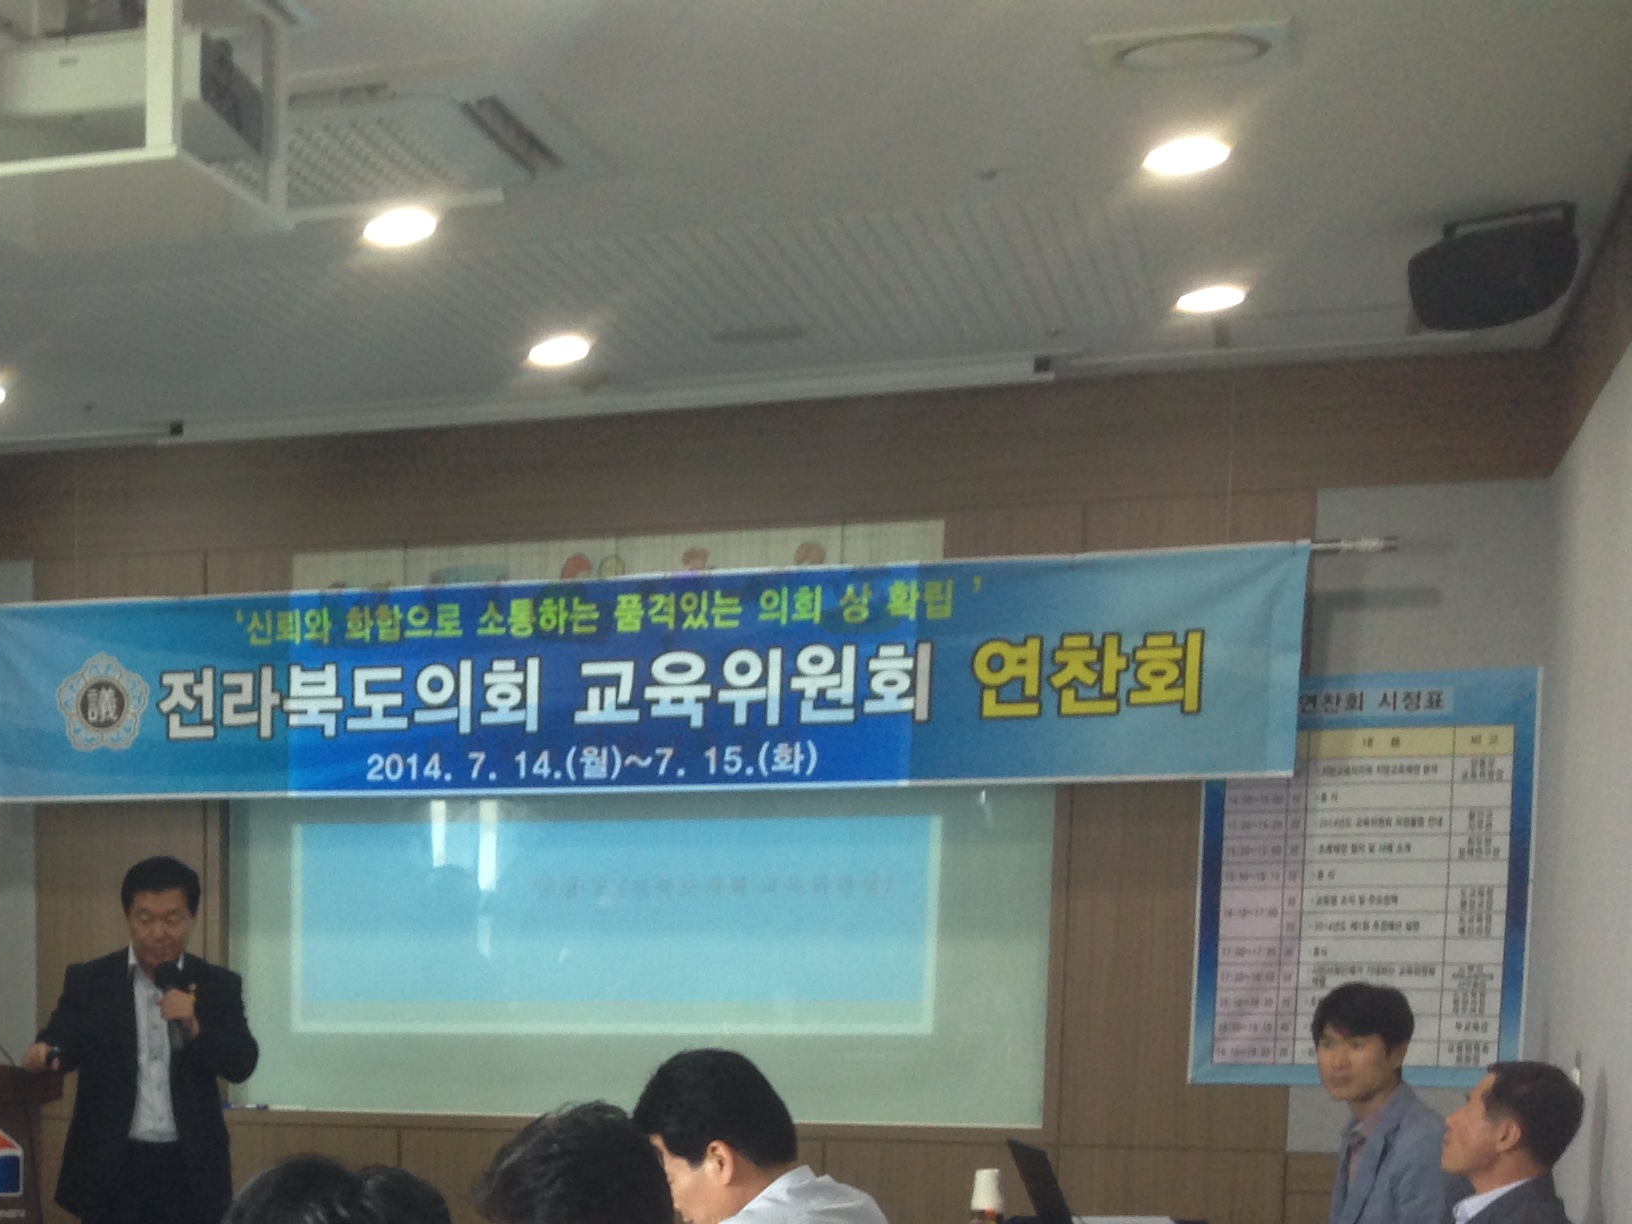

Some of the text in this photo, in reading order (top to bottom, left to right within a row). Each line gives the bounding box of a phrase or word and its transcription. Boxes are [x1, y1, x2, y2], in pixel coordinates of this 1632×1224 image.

[344, 604, 463, 642] 화합으로
[476, 598, 599, 640] 소통하는
[614, 588, 743, 635] 품격있는
[758, 585, 823, 626] 의회
[839, 583, 872, 623] 상
[156, 628, 1206, 741] 전라북도의회 교육위원회 연찬회
[366, 753, 453, 782] 2014.
[469, 752, 497, 780] 7.
[705, 740, 817, 777] 15.(화)
